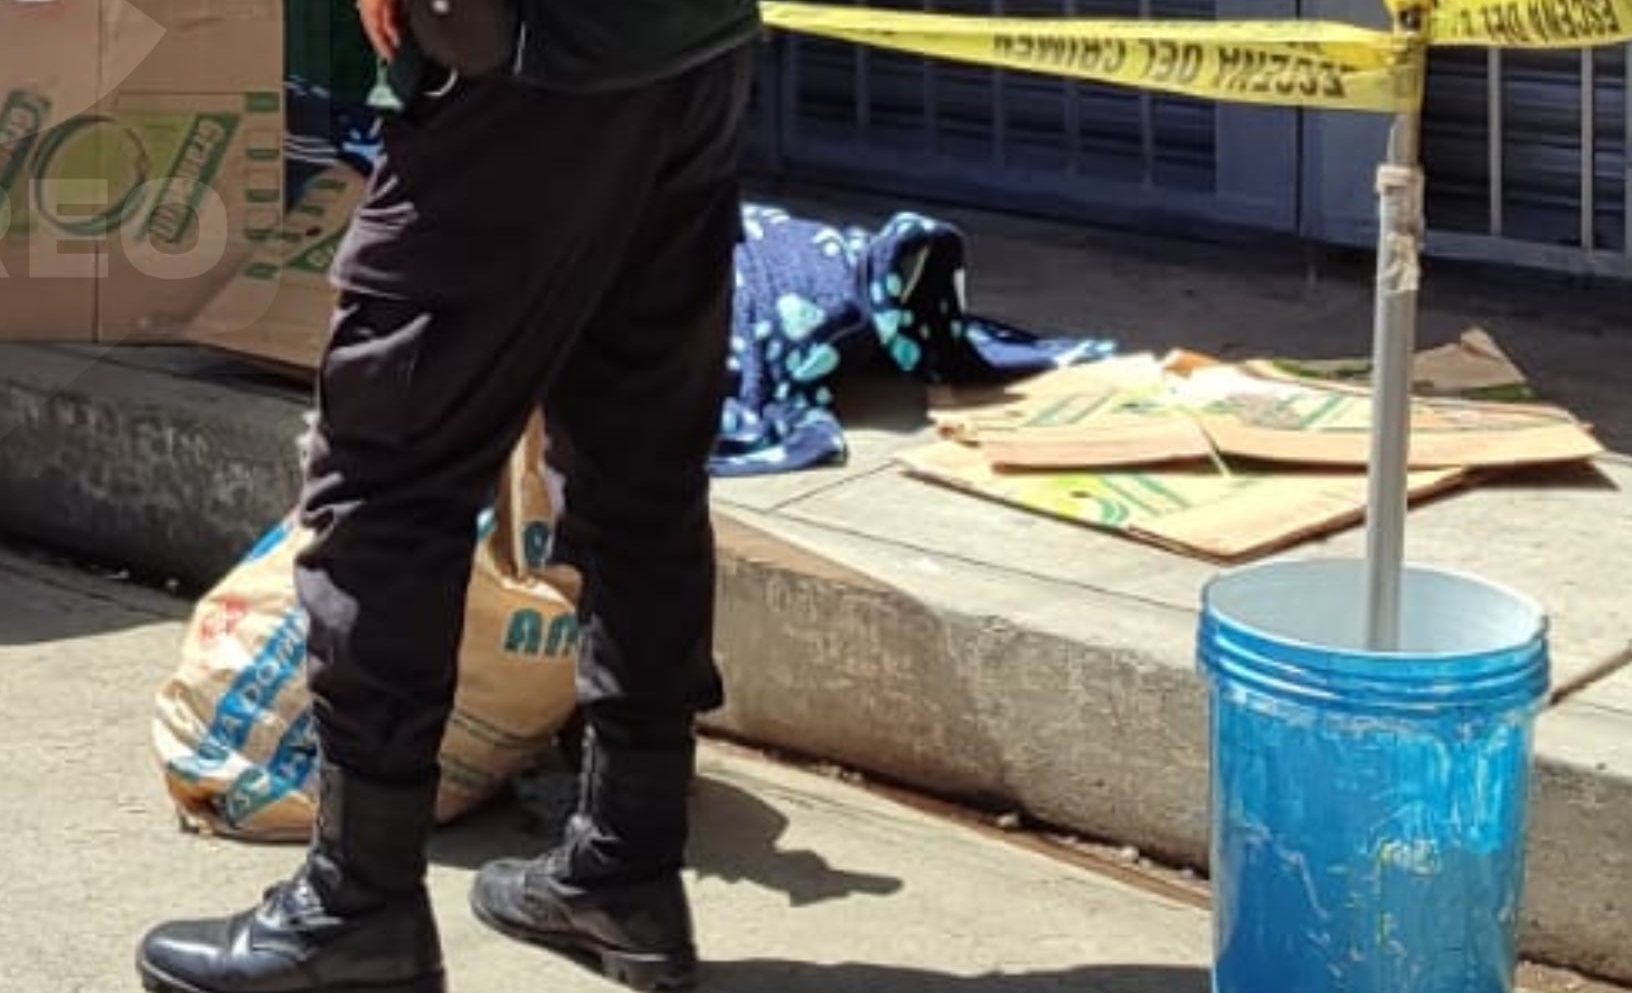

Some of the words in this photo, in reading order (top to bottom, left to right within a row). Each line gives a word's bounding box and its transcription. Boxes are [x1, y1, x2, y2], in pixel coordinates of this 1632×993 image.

[992, 34, 1126, 73] CRIMEN
[1138, 36, 1205, 84] DEL
[1216, 44, 1348, 98] ESCENA
